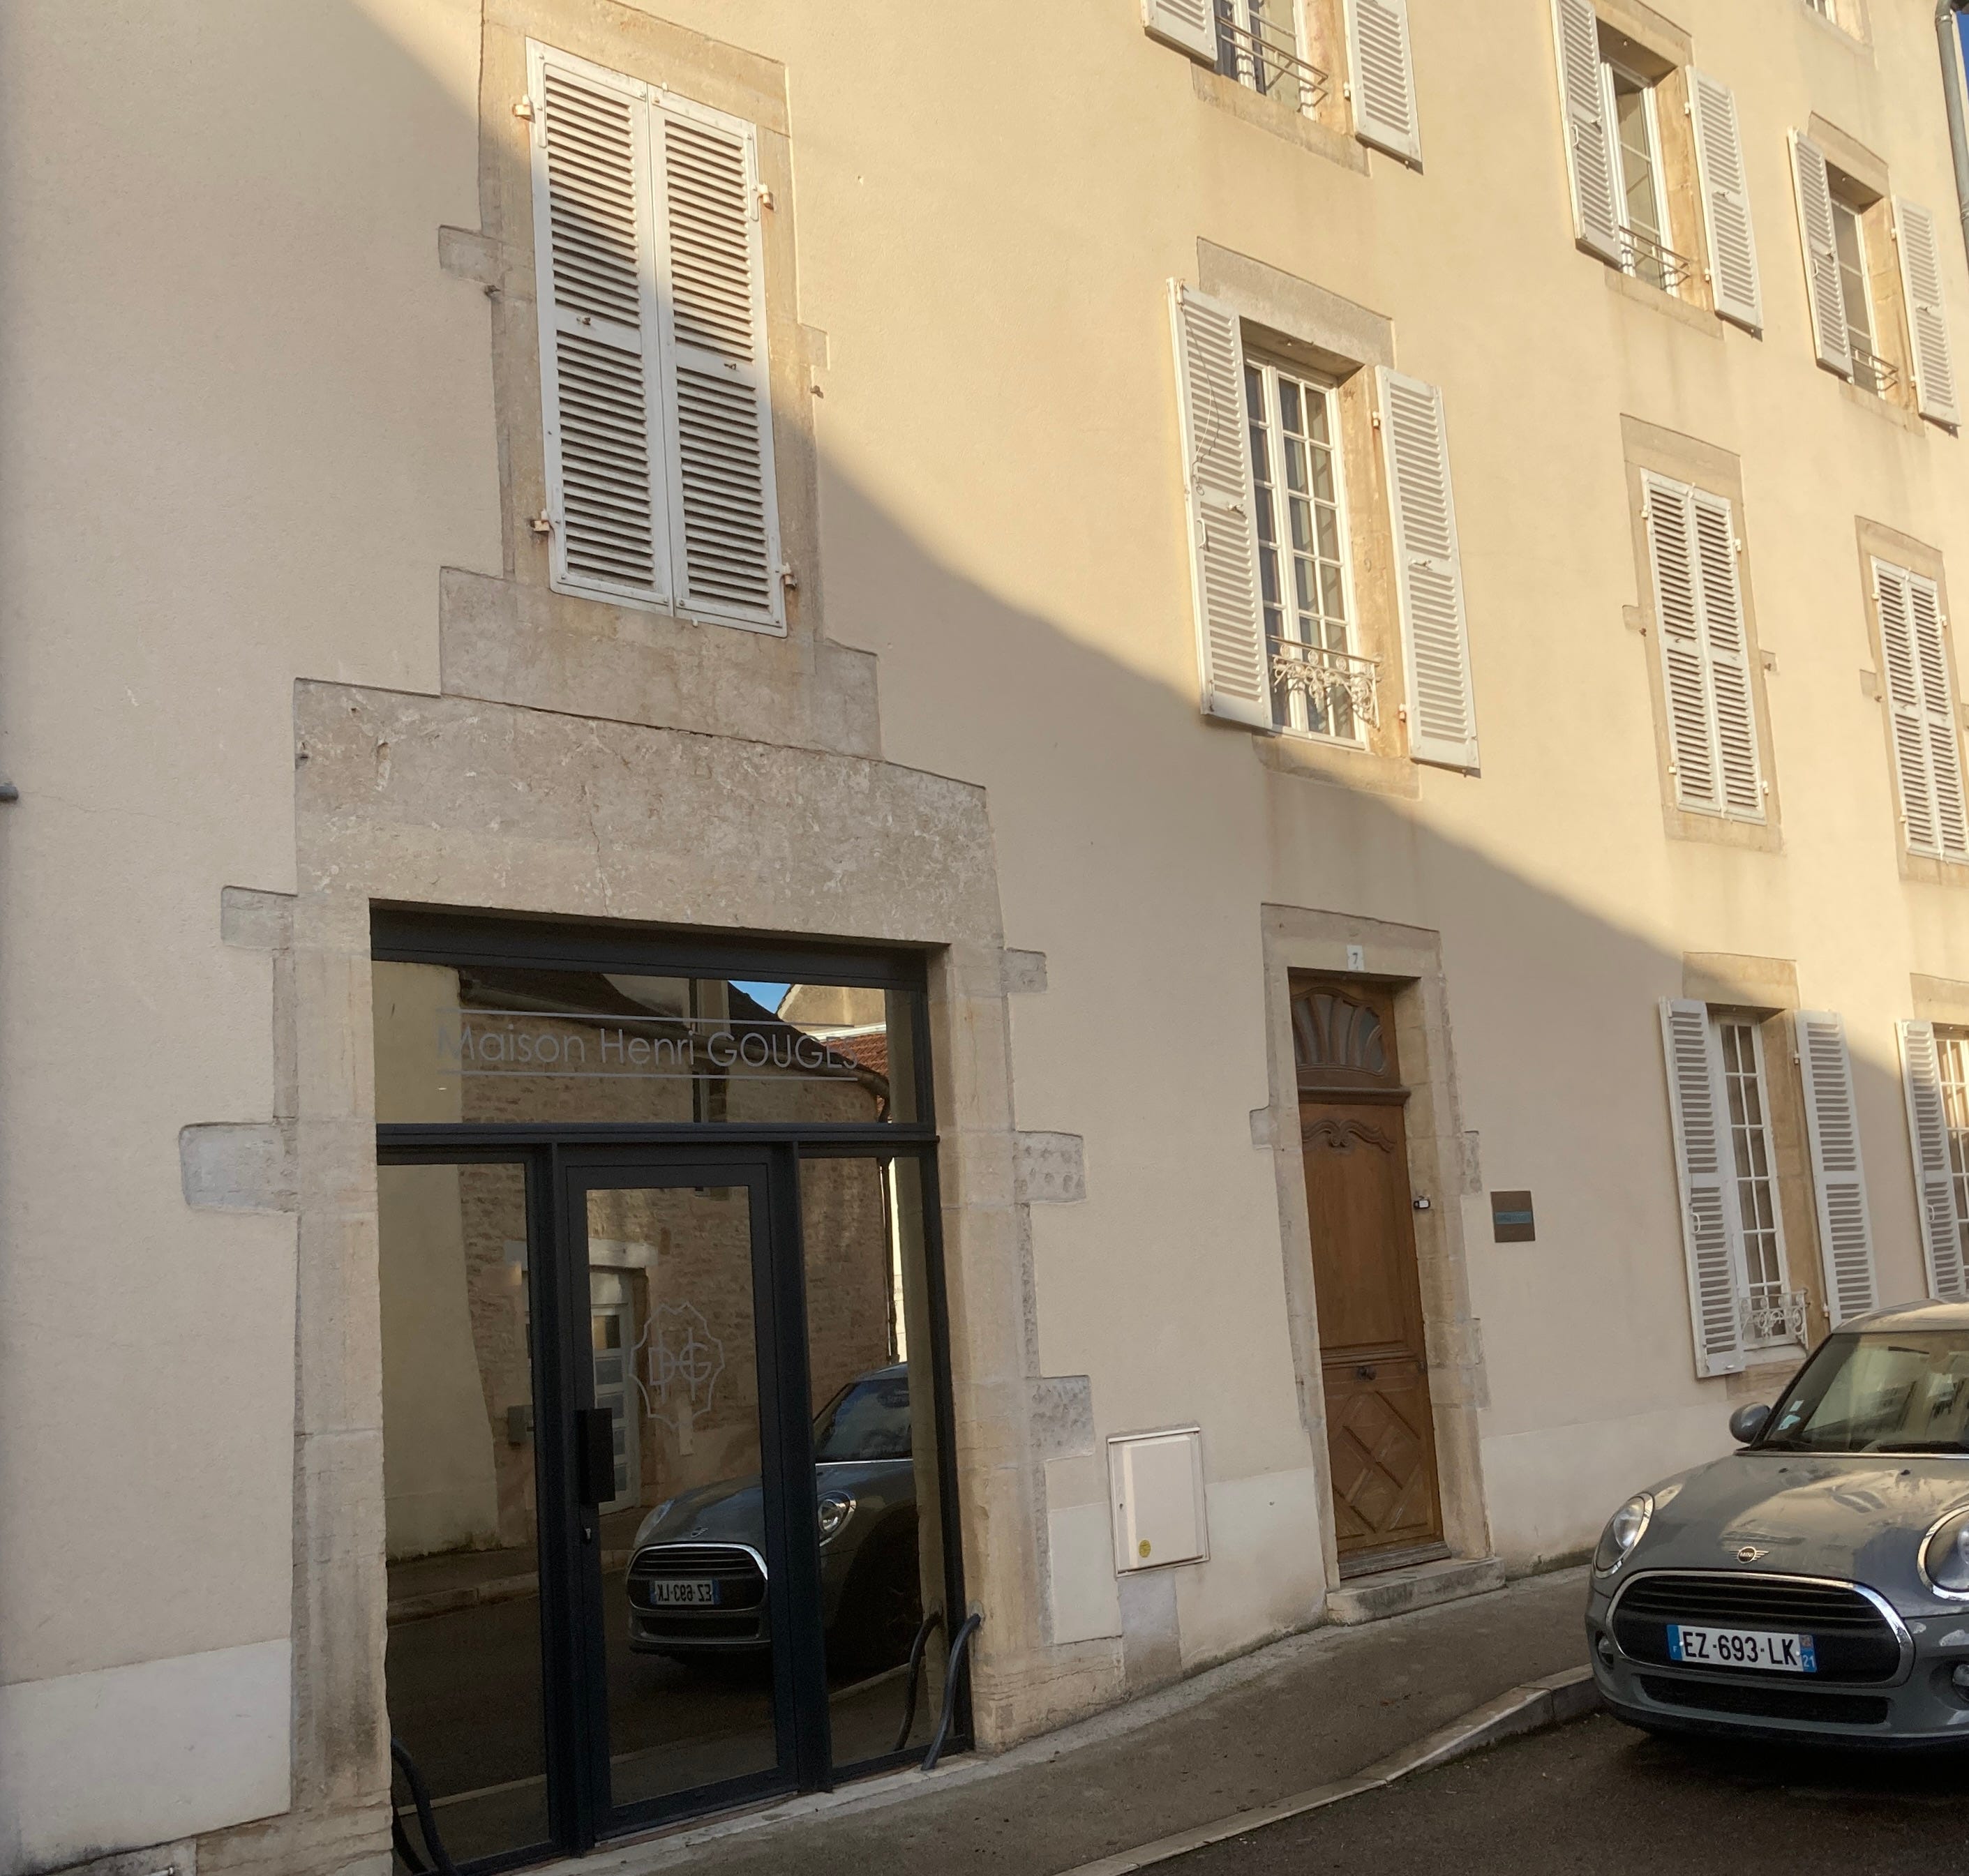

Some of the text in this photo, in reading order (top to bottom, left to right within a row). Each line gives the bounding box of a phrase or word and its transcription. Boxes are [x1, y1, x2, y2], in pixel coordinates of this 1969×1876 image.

[1352, 952, 1358, 965] 7
[438, 1023, 859, 1070] Maison Henri GOUGES
[1802, 1654, 1815, 1668] 21
